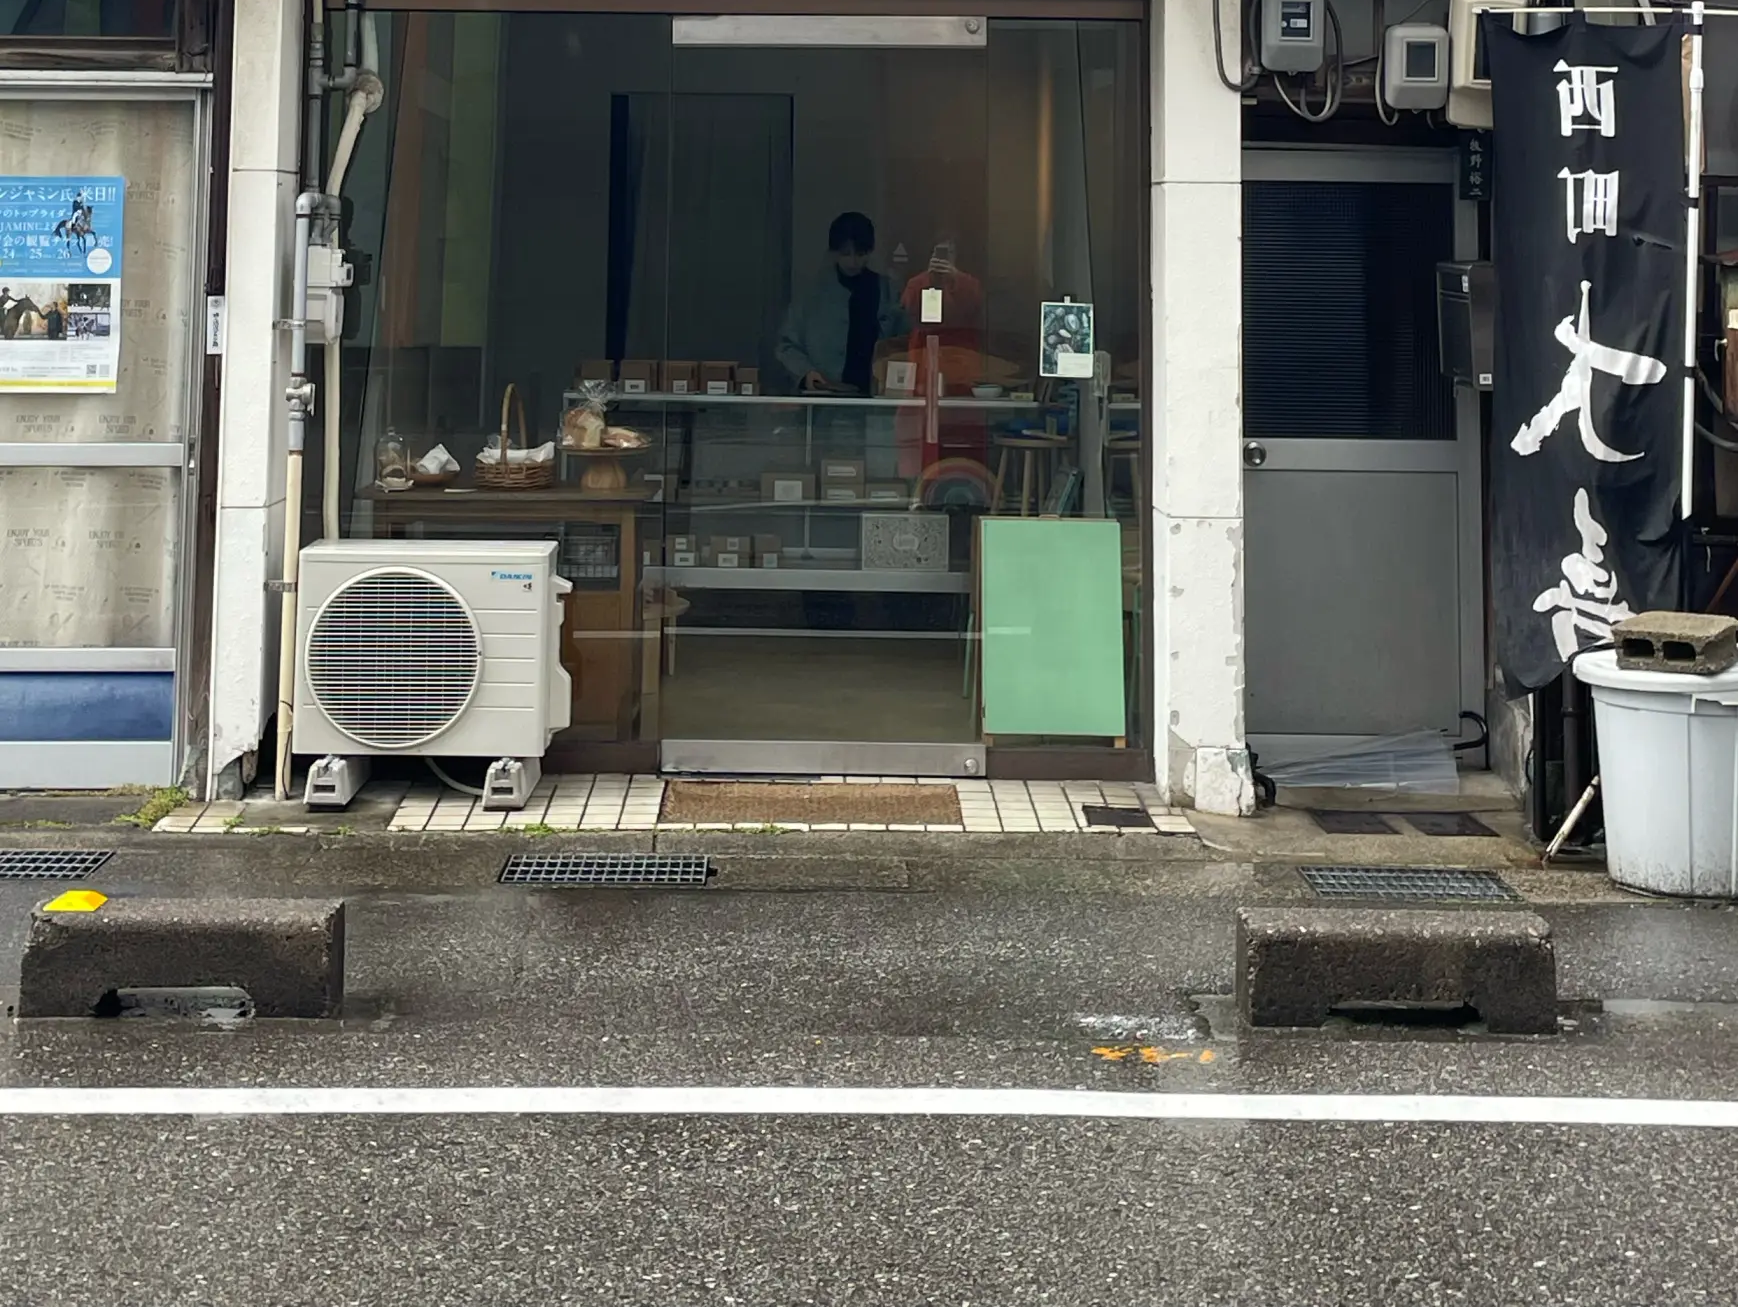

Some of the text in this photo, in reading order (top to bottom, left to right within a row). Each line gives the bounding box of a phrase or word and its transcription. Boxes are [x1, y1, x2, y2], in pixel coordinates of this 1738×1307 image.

[0, 208, 73, 219] のトップライダー
[3, 248, 15, 259] 24
[29, 248, 42, 259] 25
